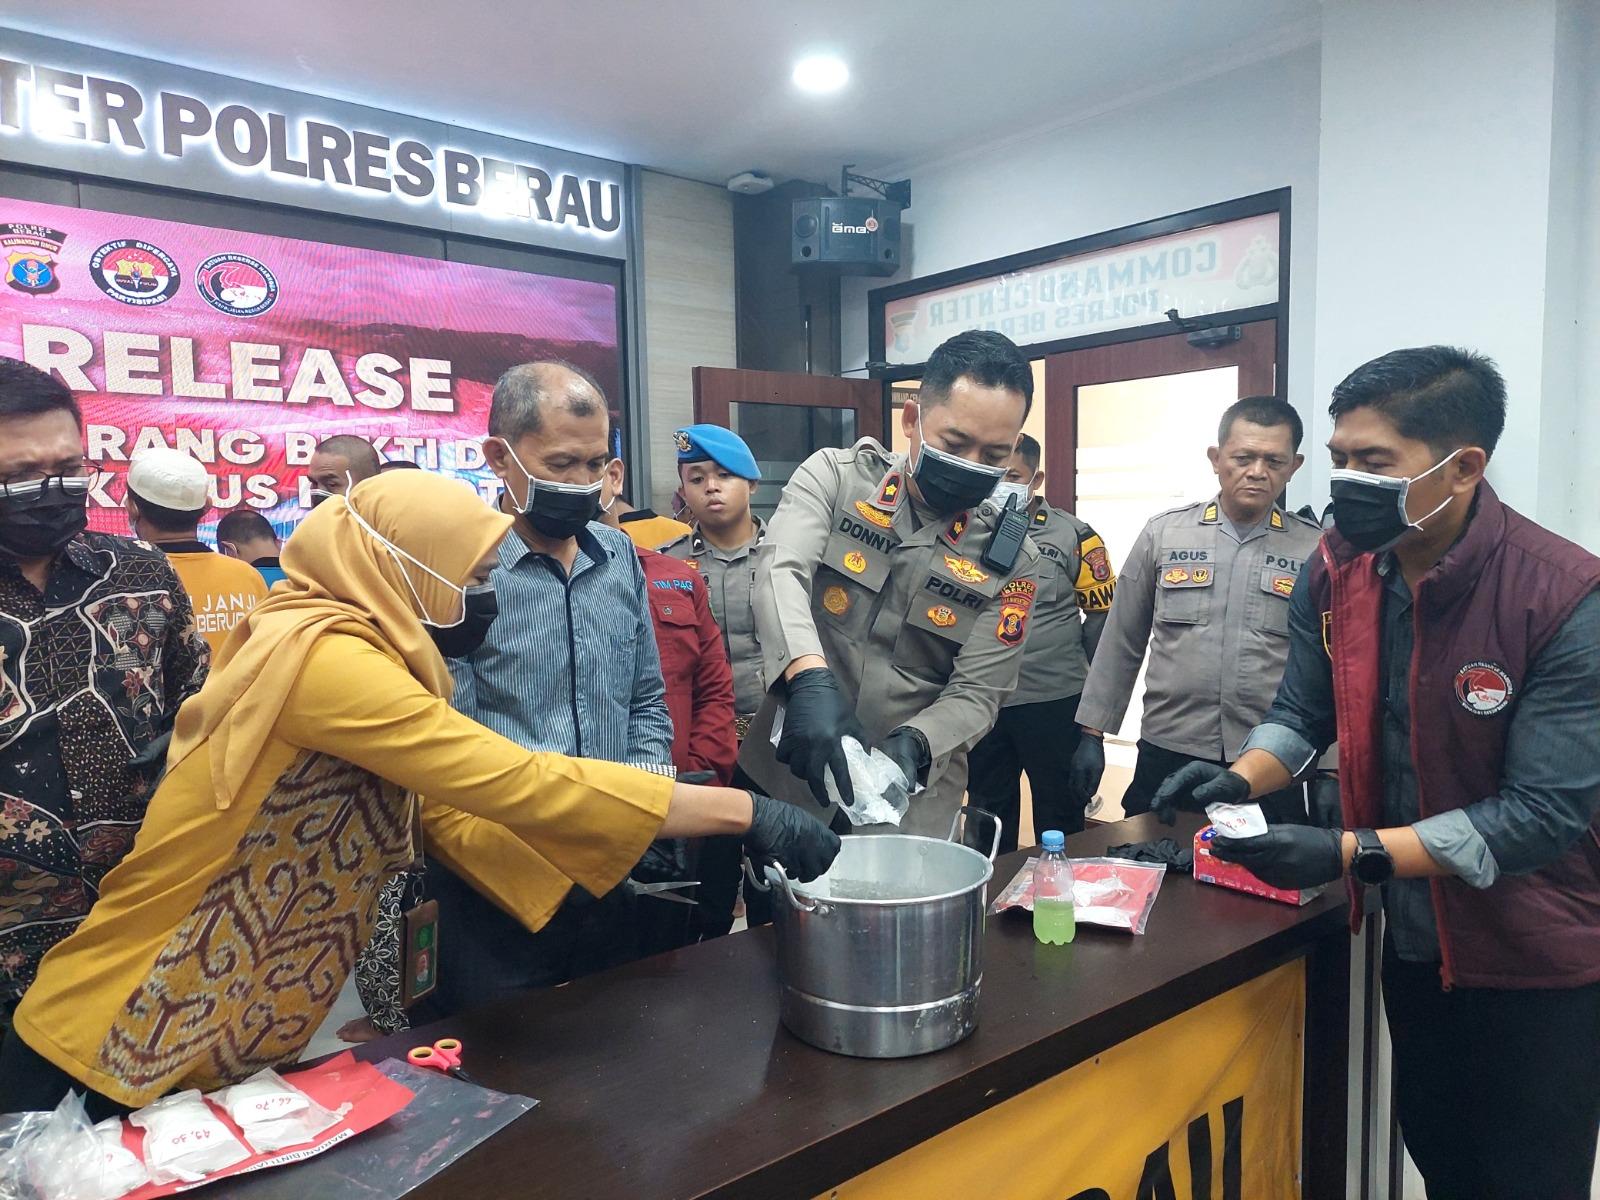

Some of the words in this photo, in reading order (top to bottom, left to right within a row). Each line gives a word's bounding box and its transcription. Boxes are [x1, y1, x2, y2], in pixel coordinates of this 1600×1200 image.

[161, 91, 435, 198] POLRES
[444, 149, 621, 232] BERAU
[22, 323, 454, 412] RELEASE
[285, 432, 438, 469] BKTI
[839, 517, 902, 554] DONNY
[1169, 551, 1208, 561] AGUS
[652, 580, 671, 589] TIM
[925, 576, 985, 609] POLRI
